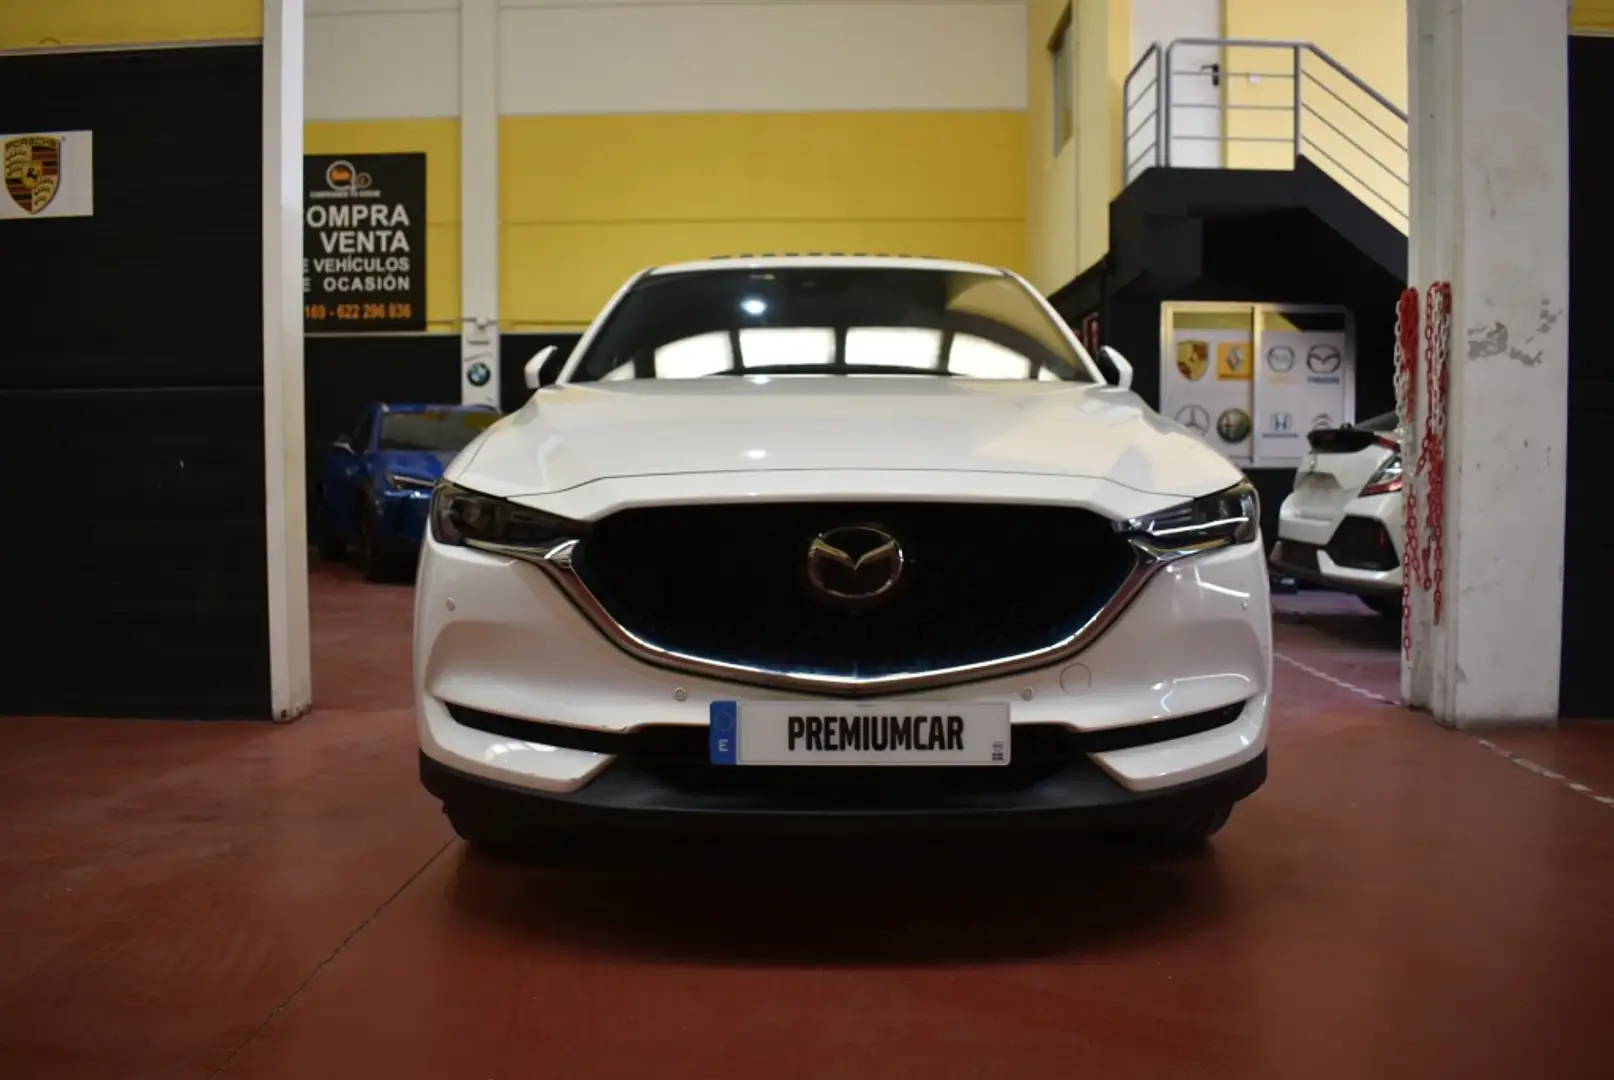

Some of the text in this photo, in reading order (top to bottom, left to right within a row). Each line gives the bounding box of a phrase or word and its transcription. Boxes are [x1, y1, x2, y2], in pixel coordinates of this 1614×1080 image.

[304, 204, 410, 228] OMPRA
[320, 230, 410, 253] VENTA
[313, 255, 410, 273] VEHÍCULOS
[323, 273, 410, 292] OCASIÓN
[718, 739, 728, 752] E
[787, 716, 964, 751] PREMIUMCAR
